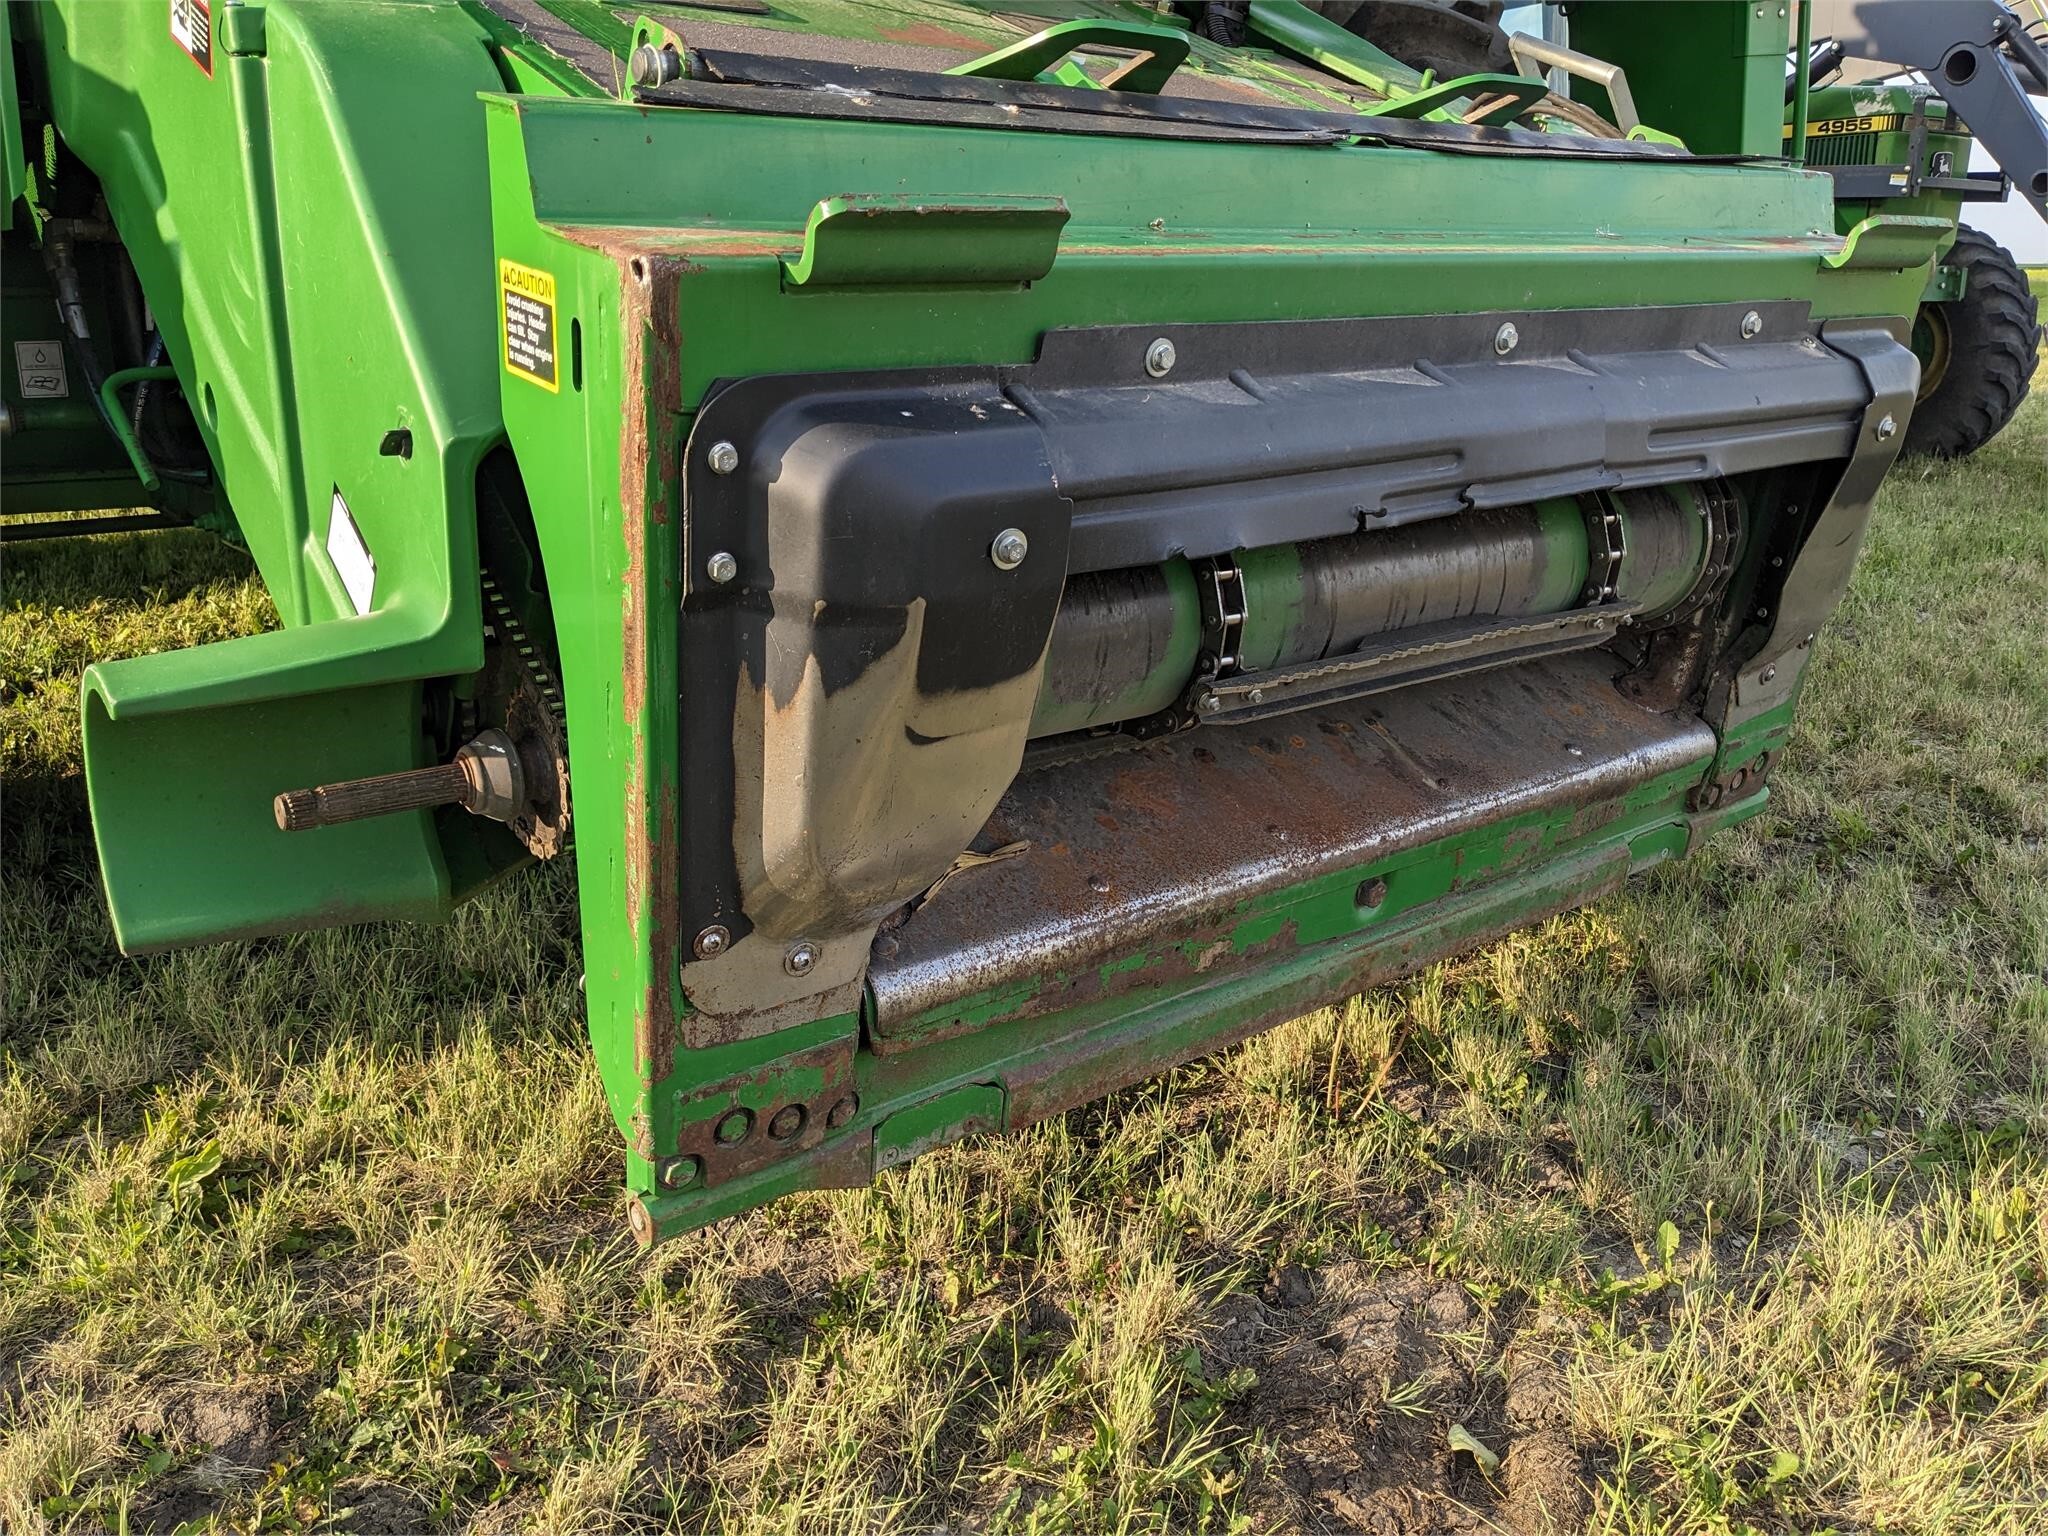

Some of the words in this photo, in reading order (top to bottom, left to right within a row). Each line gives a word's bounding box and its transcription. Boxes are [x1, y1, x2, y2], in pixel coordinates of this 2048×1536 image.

[1817, 118, 1872, 134] 4955
[510, 268, 552, 299] CAUTION
[507, 292, 521, 308] Avoid
[521, 300, 544, 320] crushing
[507, 322, 518, 334] can
[527, 328, 539, 346] Stay
[528, 314, 547, 332] Header
[508, 335, 521, 349] clear
[521, 341, 535, 355] when
[535, 348, 552, 363] engine
[508, 347, 514, 360] is
